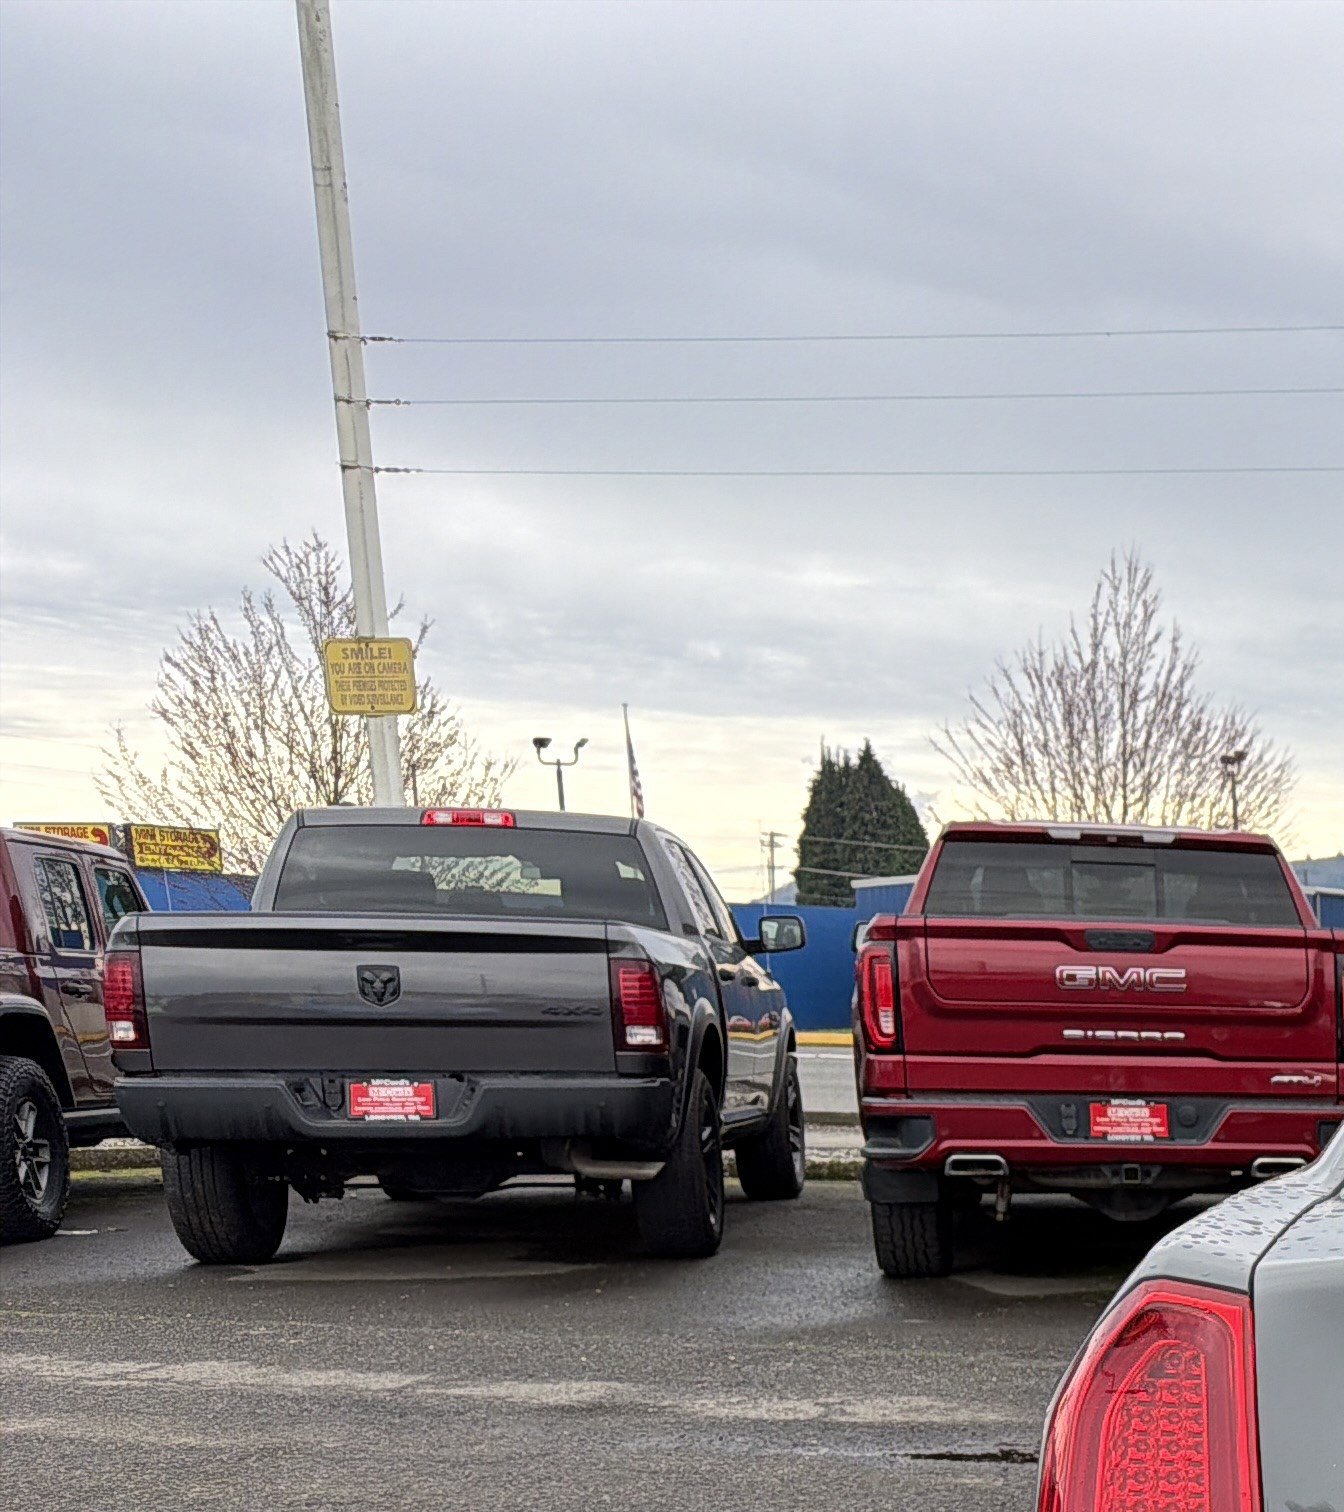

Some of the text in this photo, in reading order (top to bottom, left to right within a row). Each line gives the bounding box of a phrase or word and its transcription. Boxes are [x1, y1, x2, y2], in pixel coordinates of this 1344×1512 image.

[341, 647, 392, 660] SMILE!
[330, 662, 409, 675] YOU ARE ON CAMERA
[1055, 965, 1187, 992] GMC
